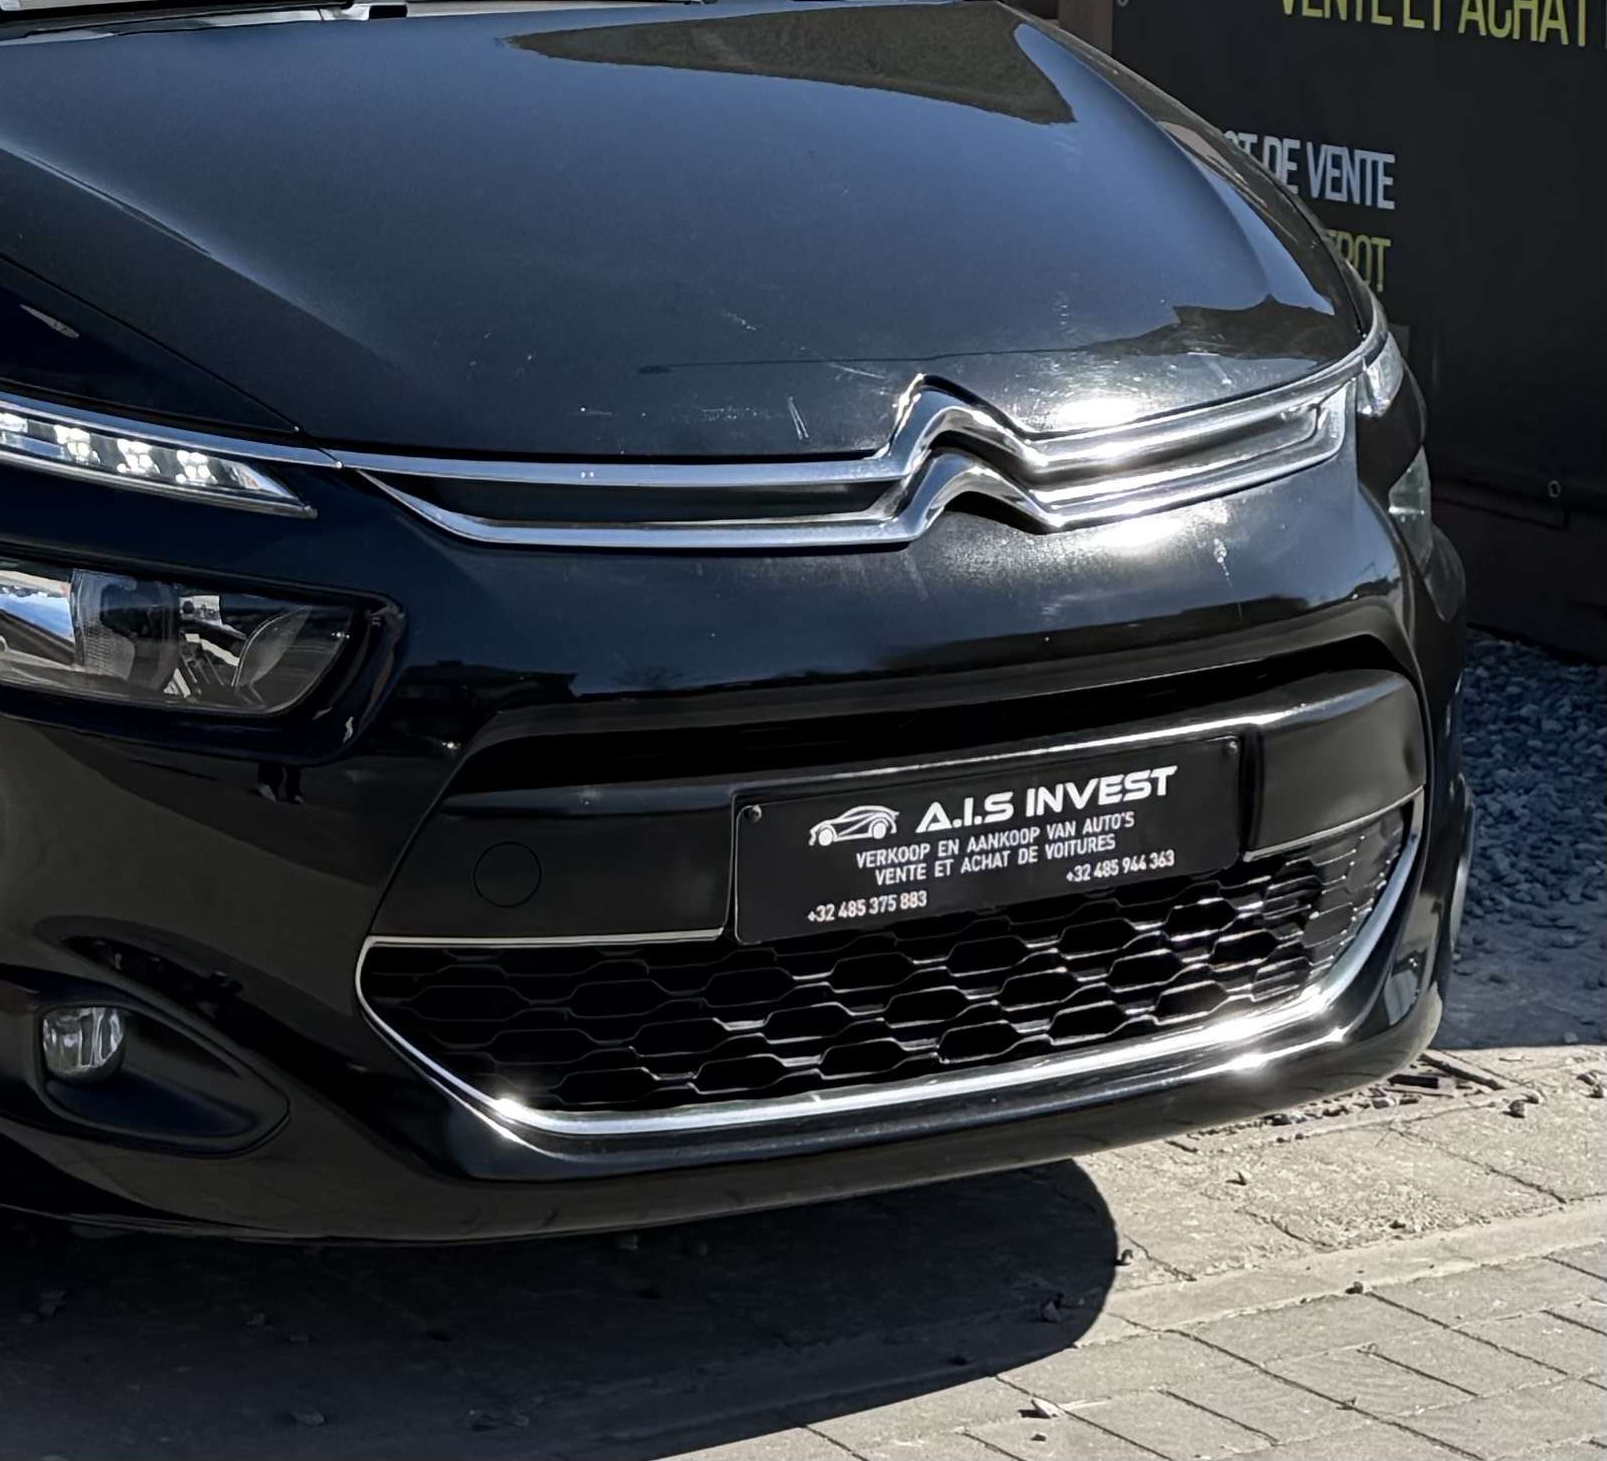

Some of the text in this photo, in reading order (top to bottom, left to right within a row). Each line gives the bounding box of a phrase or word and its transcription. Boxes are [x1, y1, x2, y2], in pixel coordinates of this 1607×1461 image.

[1305, 141, 1396, 211] VENTE
[915, 765, 1179, 833] A.I.S INVEST
[856, 811, 1135, 869] VERKOOP EN AANKOOP VAN AUTO'S
[875, 833, 1116, 886] VENTE ET ACHAT DE VOITURES
[1066, 863, 1091, 883] +32
[1093, 859, 1119, 879] 485
[1149, 849, 1175, 870] 363
[808, 890, 927, 922] +32 485 375 883
